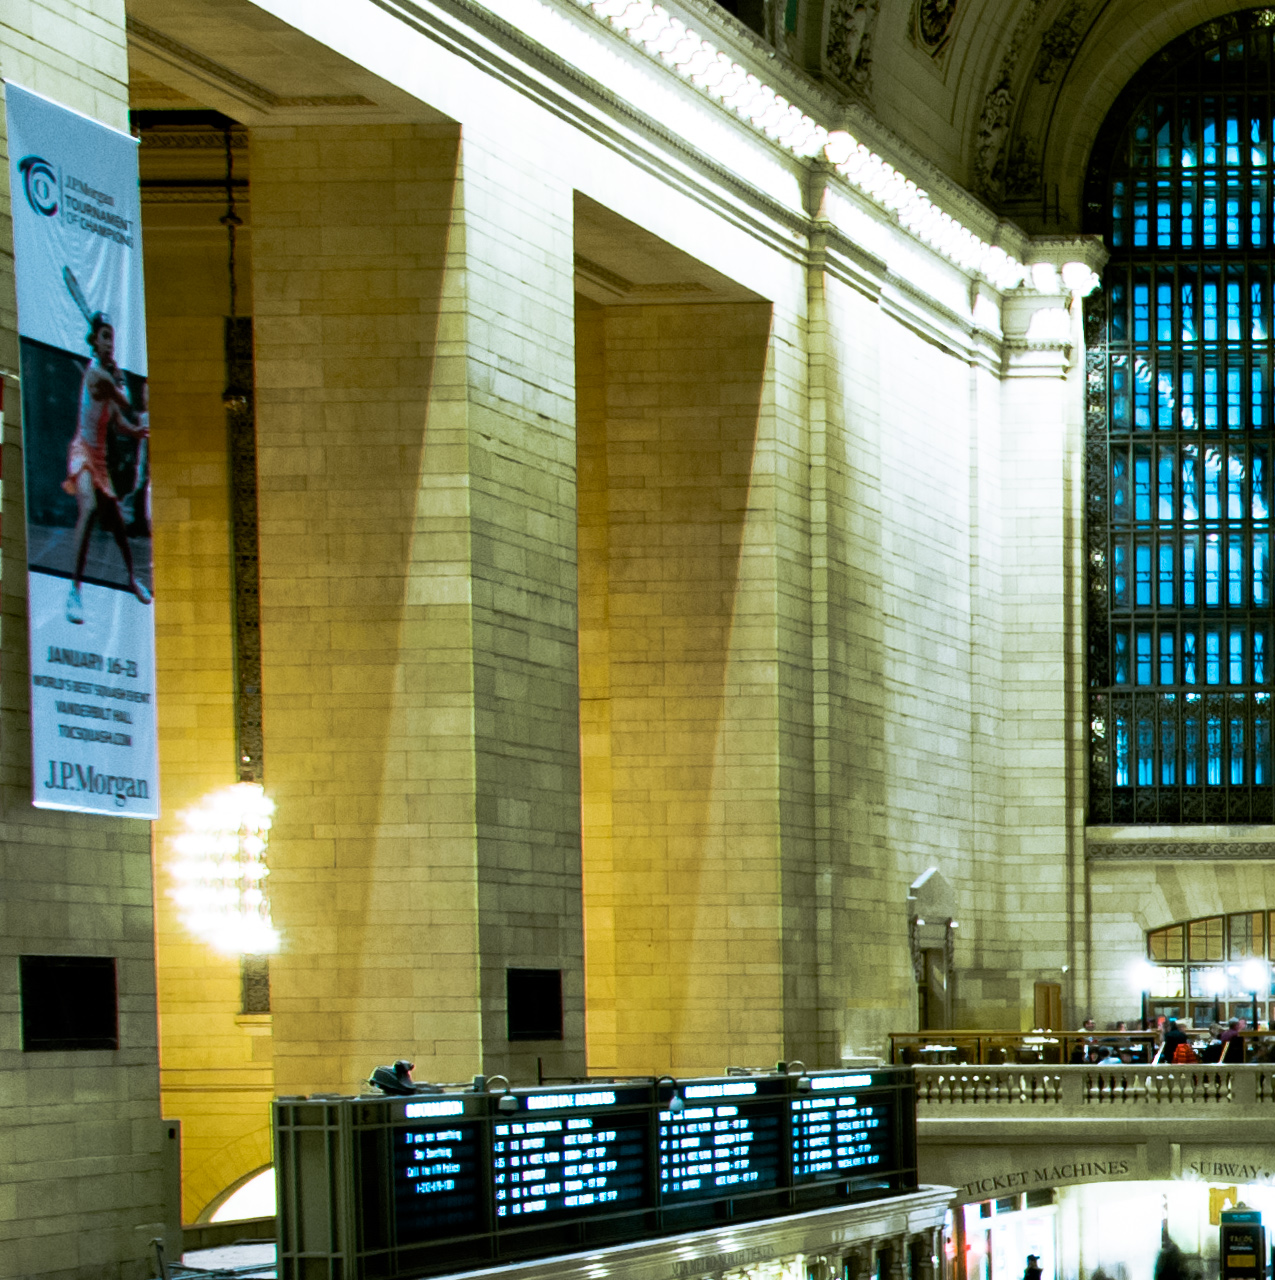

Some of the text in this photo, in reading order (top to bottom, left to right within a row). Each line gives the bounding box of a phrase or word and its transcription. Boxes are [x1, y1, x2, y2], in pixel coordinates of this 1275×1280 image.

[48, 646, 103, 671] JANUARY
[963, 1159, 1129, 1196] TICKET MACHINES
[1190, 1161, 1261, 1179] SUBWAY
